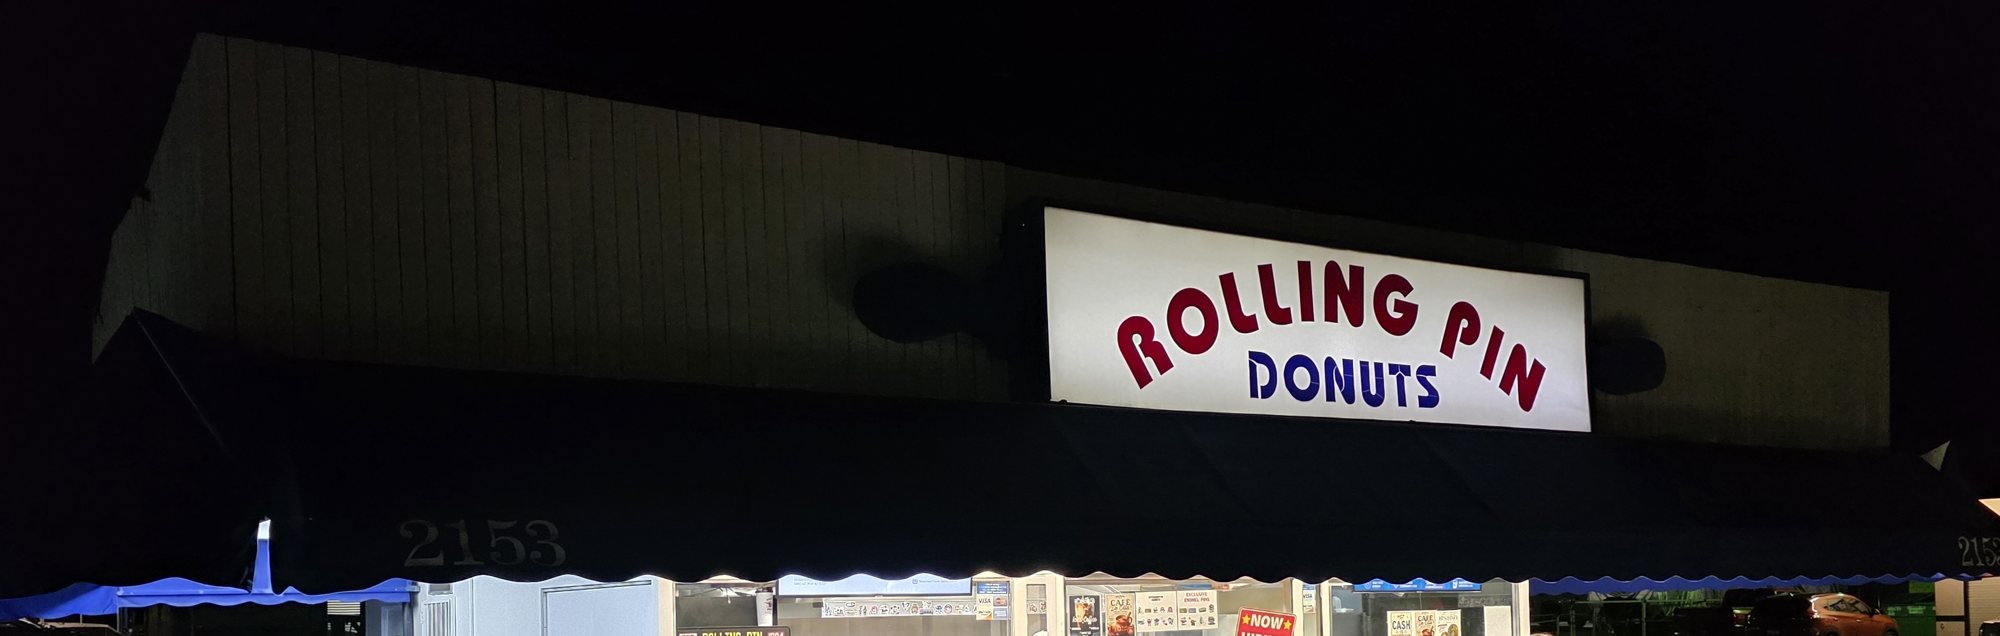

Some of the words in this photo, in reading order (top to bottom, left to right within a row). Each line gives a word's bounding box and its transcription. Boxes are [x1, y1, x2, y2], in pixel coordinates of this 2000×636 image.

[1116, 260, 1419, 390] ROLLING
[1439, 301, 1547, 413] PIN
[1248, 350, 1440, 409] DONUTS
[399, 518, 566, 567] 2153
[1250, 613, 1284, 630] NOW
[1392, 620, 1411, 630] CASH
